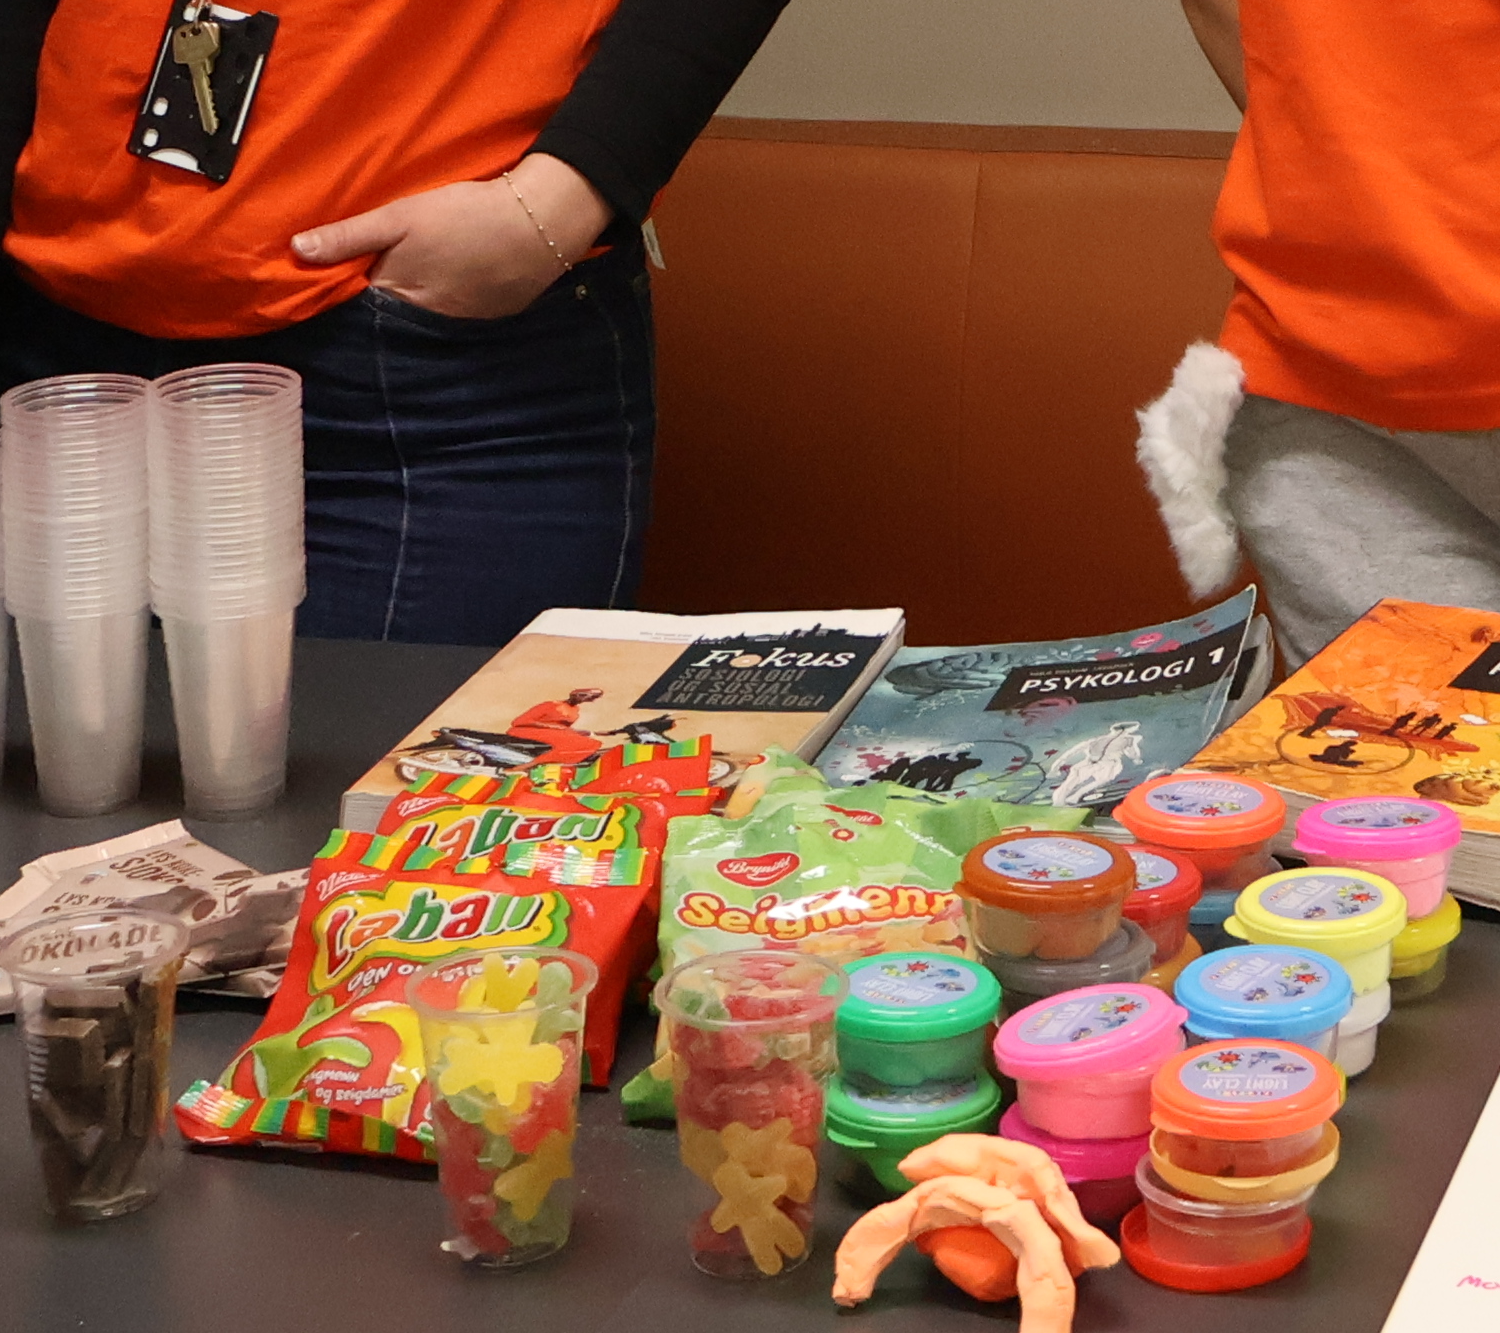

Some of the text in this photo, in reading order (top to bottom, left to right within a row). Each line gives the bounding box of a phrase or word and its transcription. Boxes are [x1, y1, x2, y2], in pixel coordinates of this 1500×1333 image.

[679, 667, 808, 683] SOSIOLOGI
[1019, 656, 1196, 694] PSYKOLOGI
[1208, 645, 1225, 665] 1
[712, 680, 792, 695] SOSIAL
[324, 888, 545, 980] Laban
[1202, 1075, 1289, 1090] LIGHT CLAY
